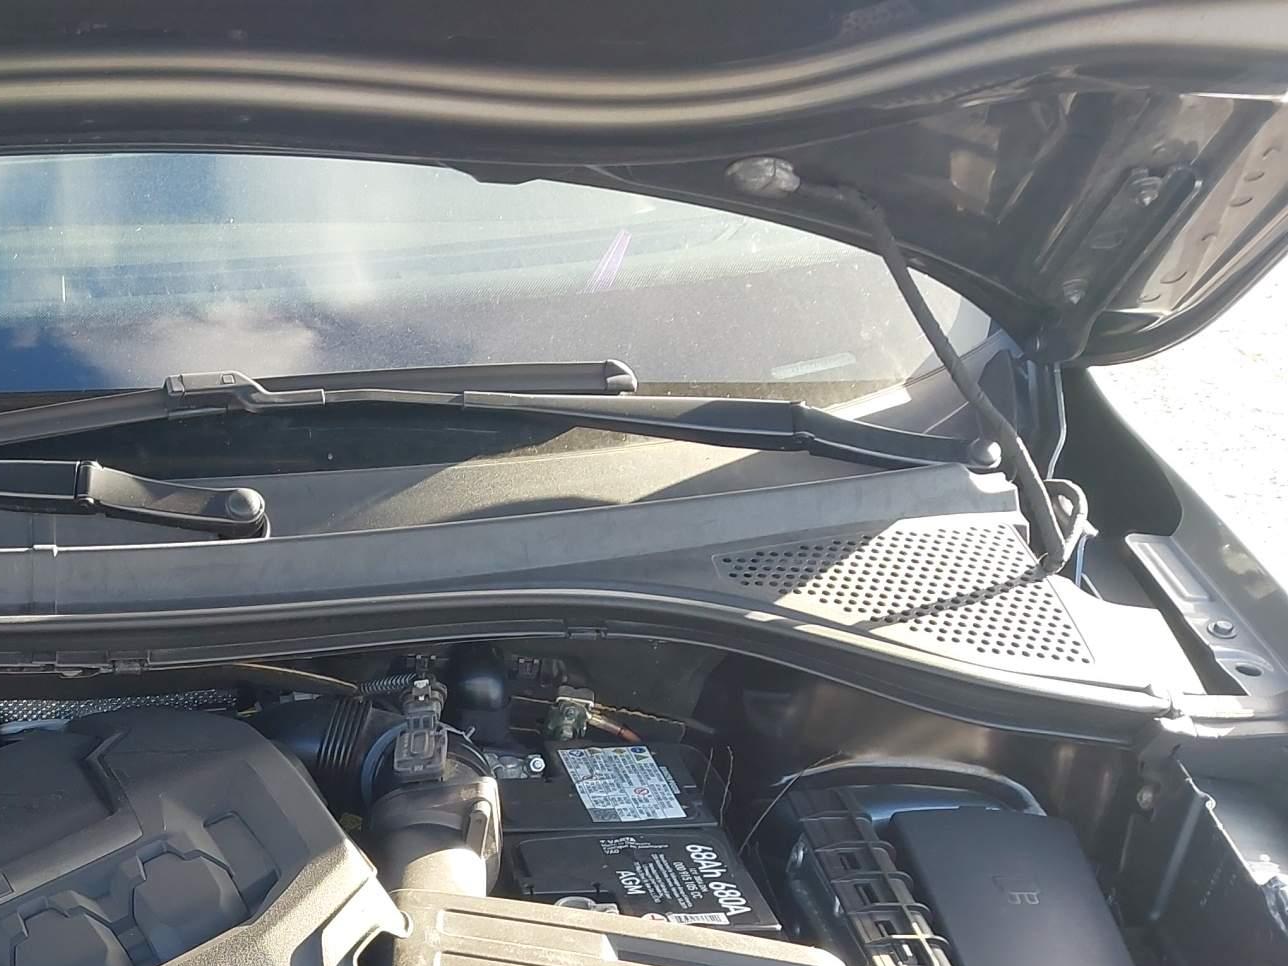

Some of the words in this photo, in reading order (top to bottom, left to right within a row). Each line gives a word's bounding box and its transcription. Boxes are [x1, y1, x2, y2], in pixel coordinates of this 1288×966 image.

[615, 870, 647, 895] AGM
[685, 844, 727, 878] 68Ah
[708, 881, 752, 916] 680A
